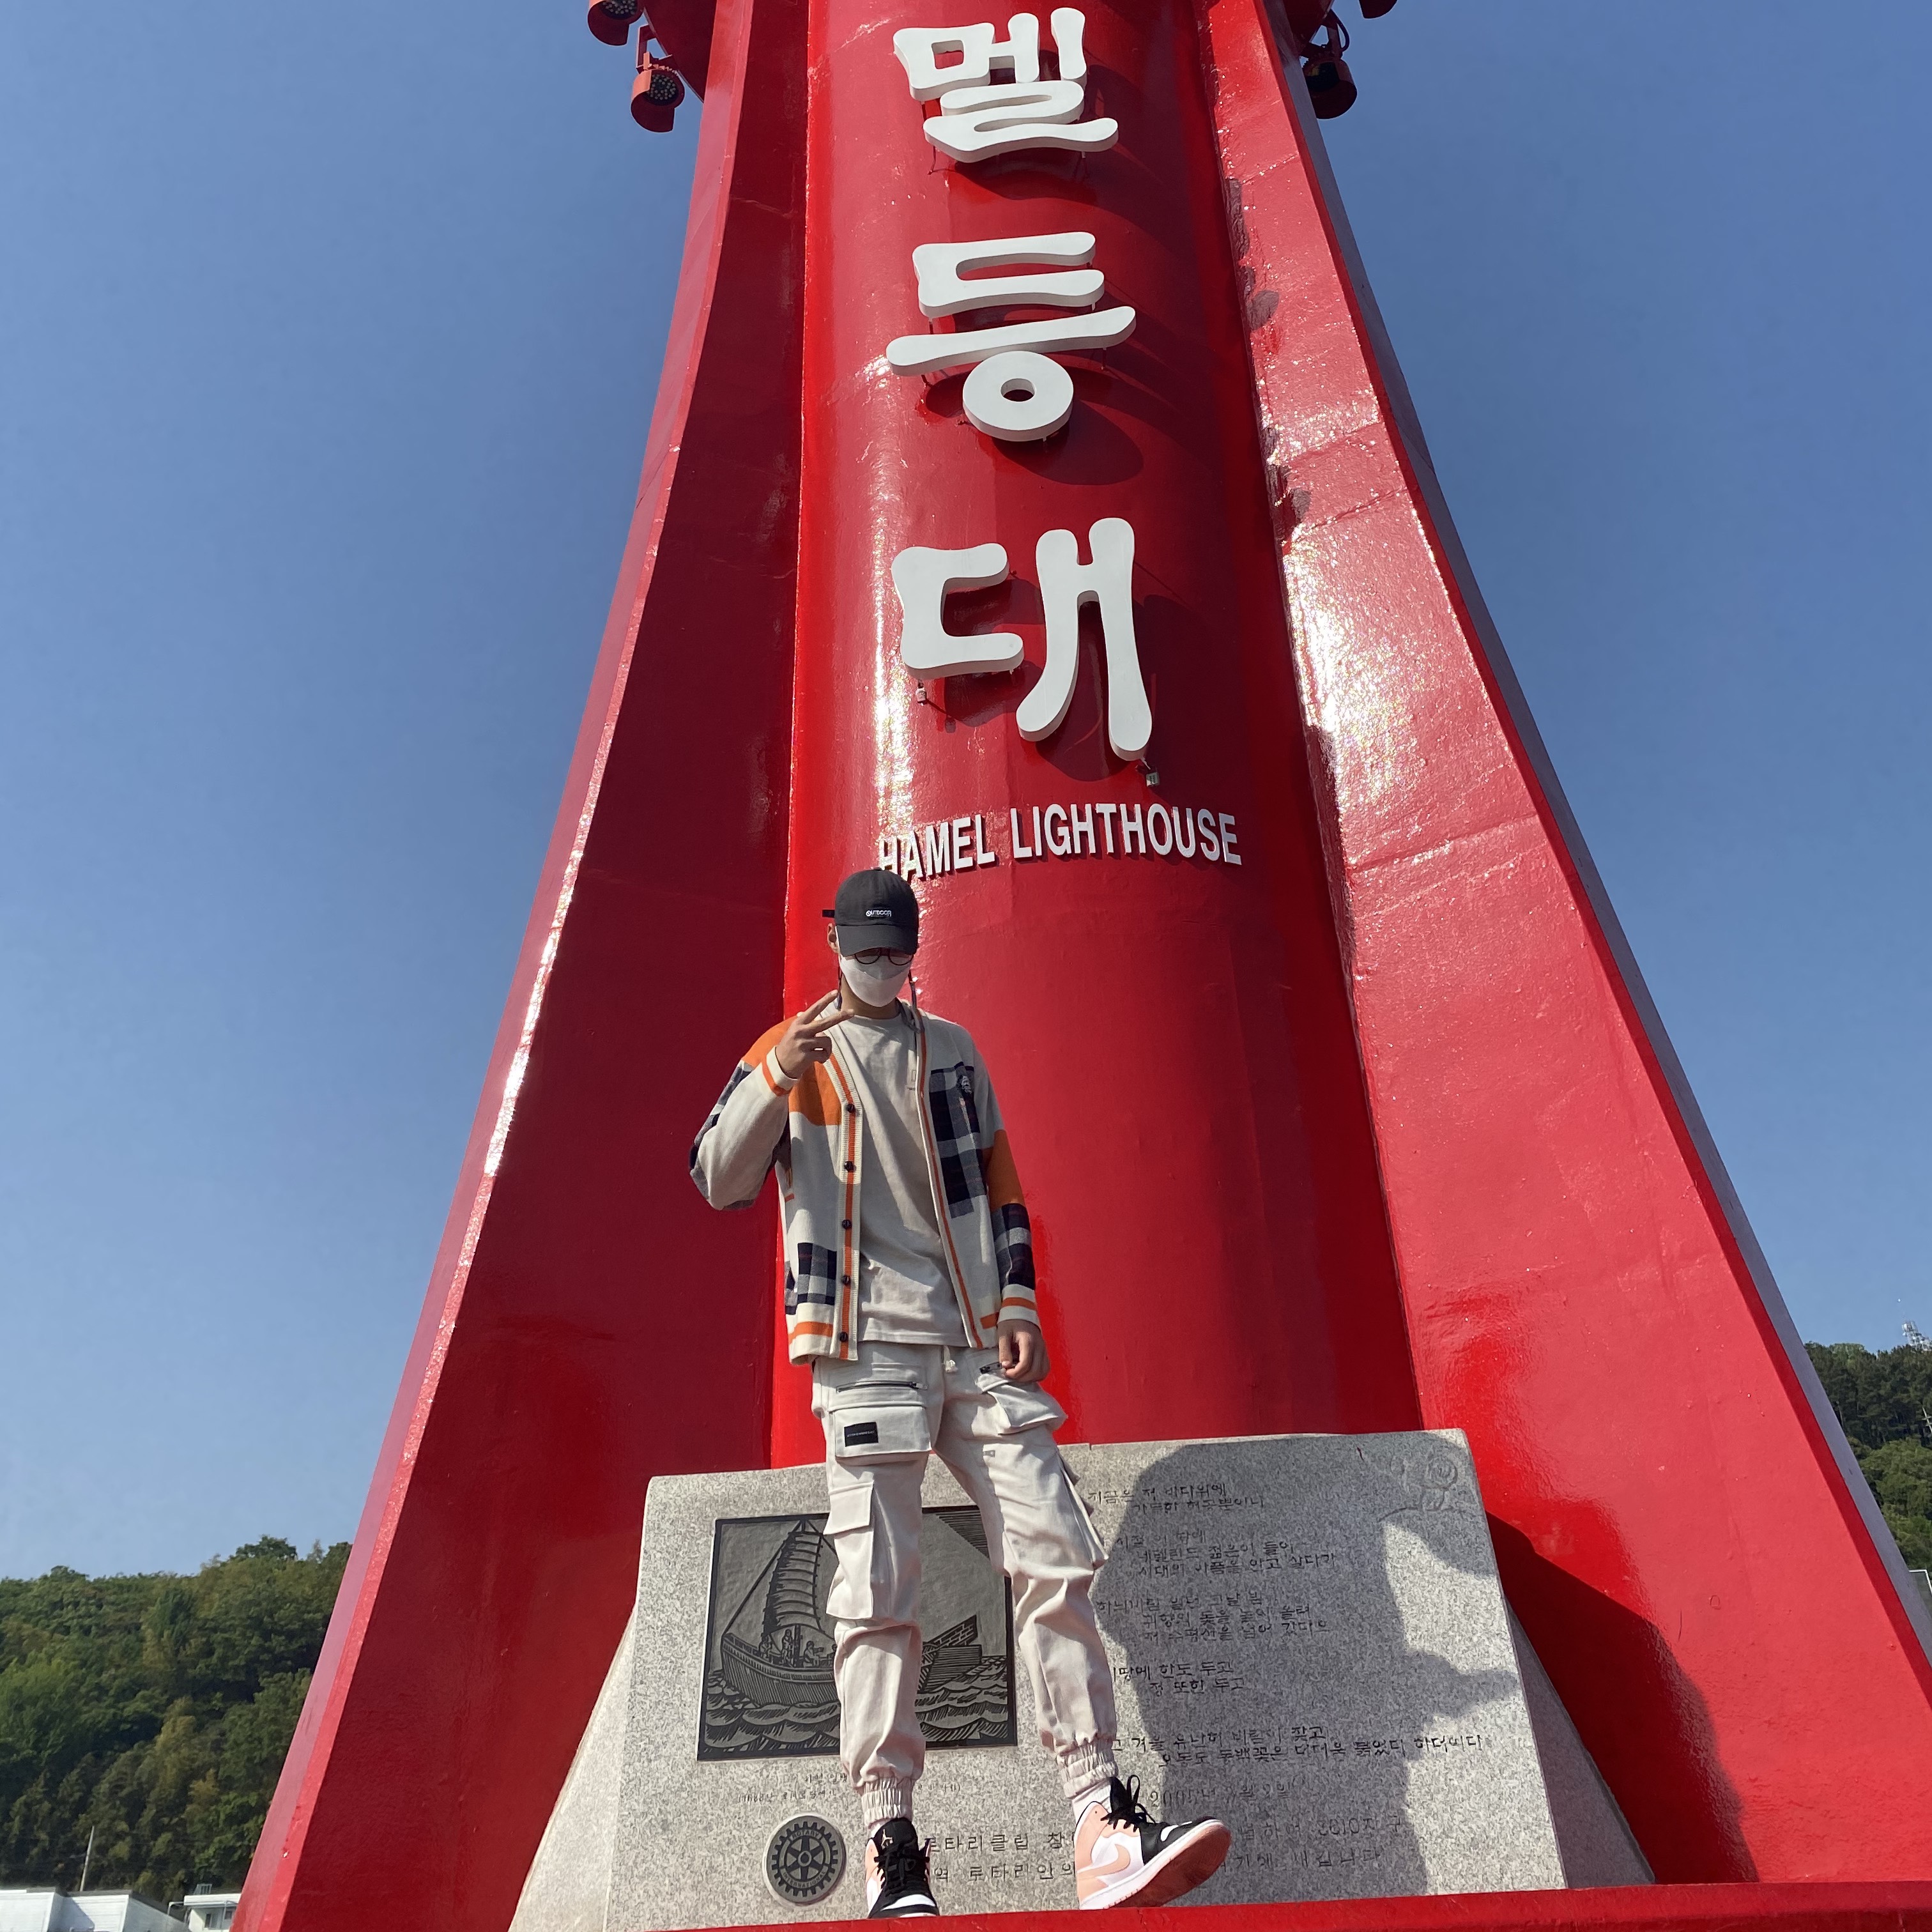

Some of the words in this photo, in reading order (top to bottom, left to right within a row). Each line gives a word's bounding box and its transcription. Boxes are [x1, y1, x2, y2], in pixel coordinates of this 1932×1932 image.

[877, 813, 996, 882] HAMEL
[1011, 802, 1242, 866] LIGHTHOUSE
[1087, 1490, 1135, 1504] 지금은
[1165, 1483, 1226, 1501] 바다위에
[1159, 1663, 1193, 1679] 한도
[1200, 1661, 1234, 1676] 두고
[1173, 1679, 1205, 1694] 또한
[1215, 1677, 1245, 1693] 두고
[1131, 1735, 1165, 1753] 겨울
[793, 1830, 820, 1839] ROTARY
[1047, 1831, 1075, 1850] 창
